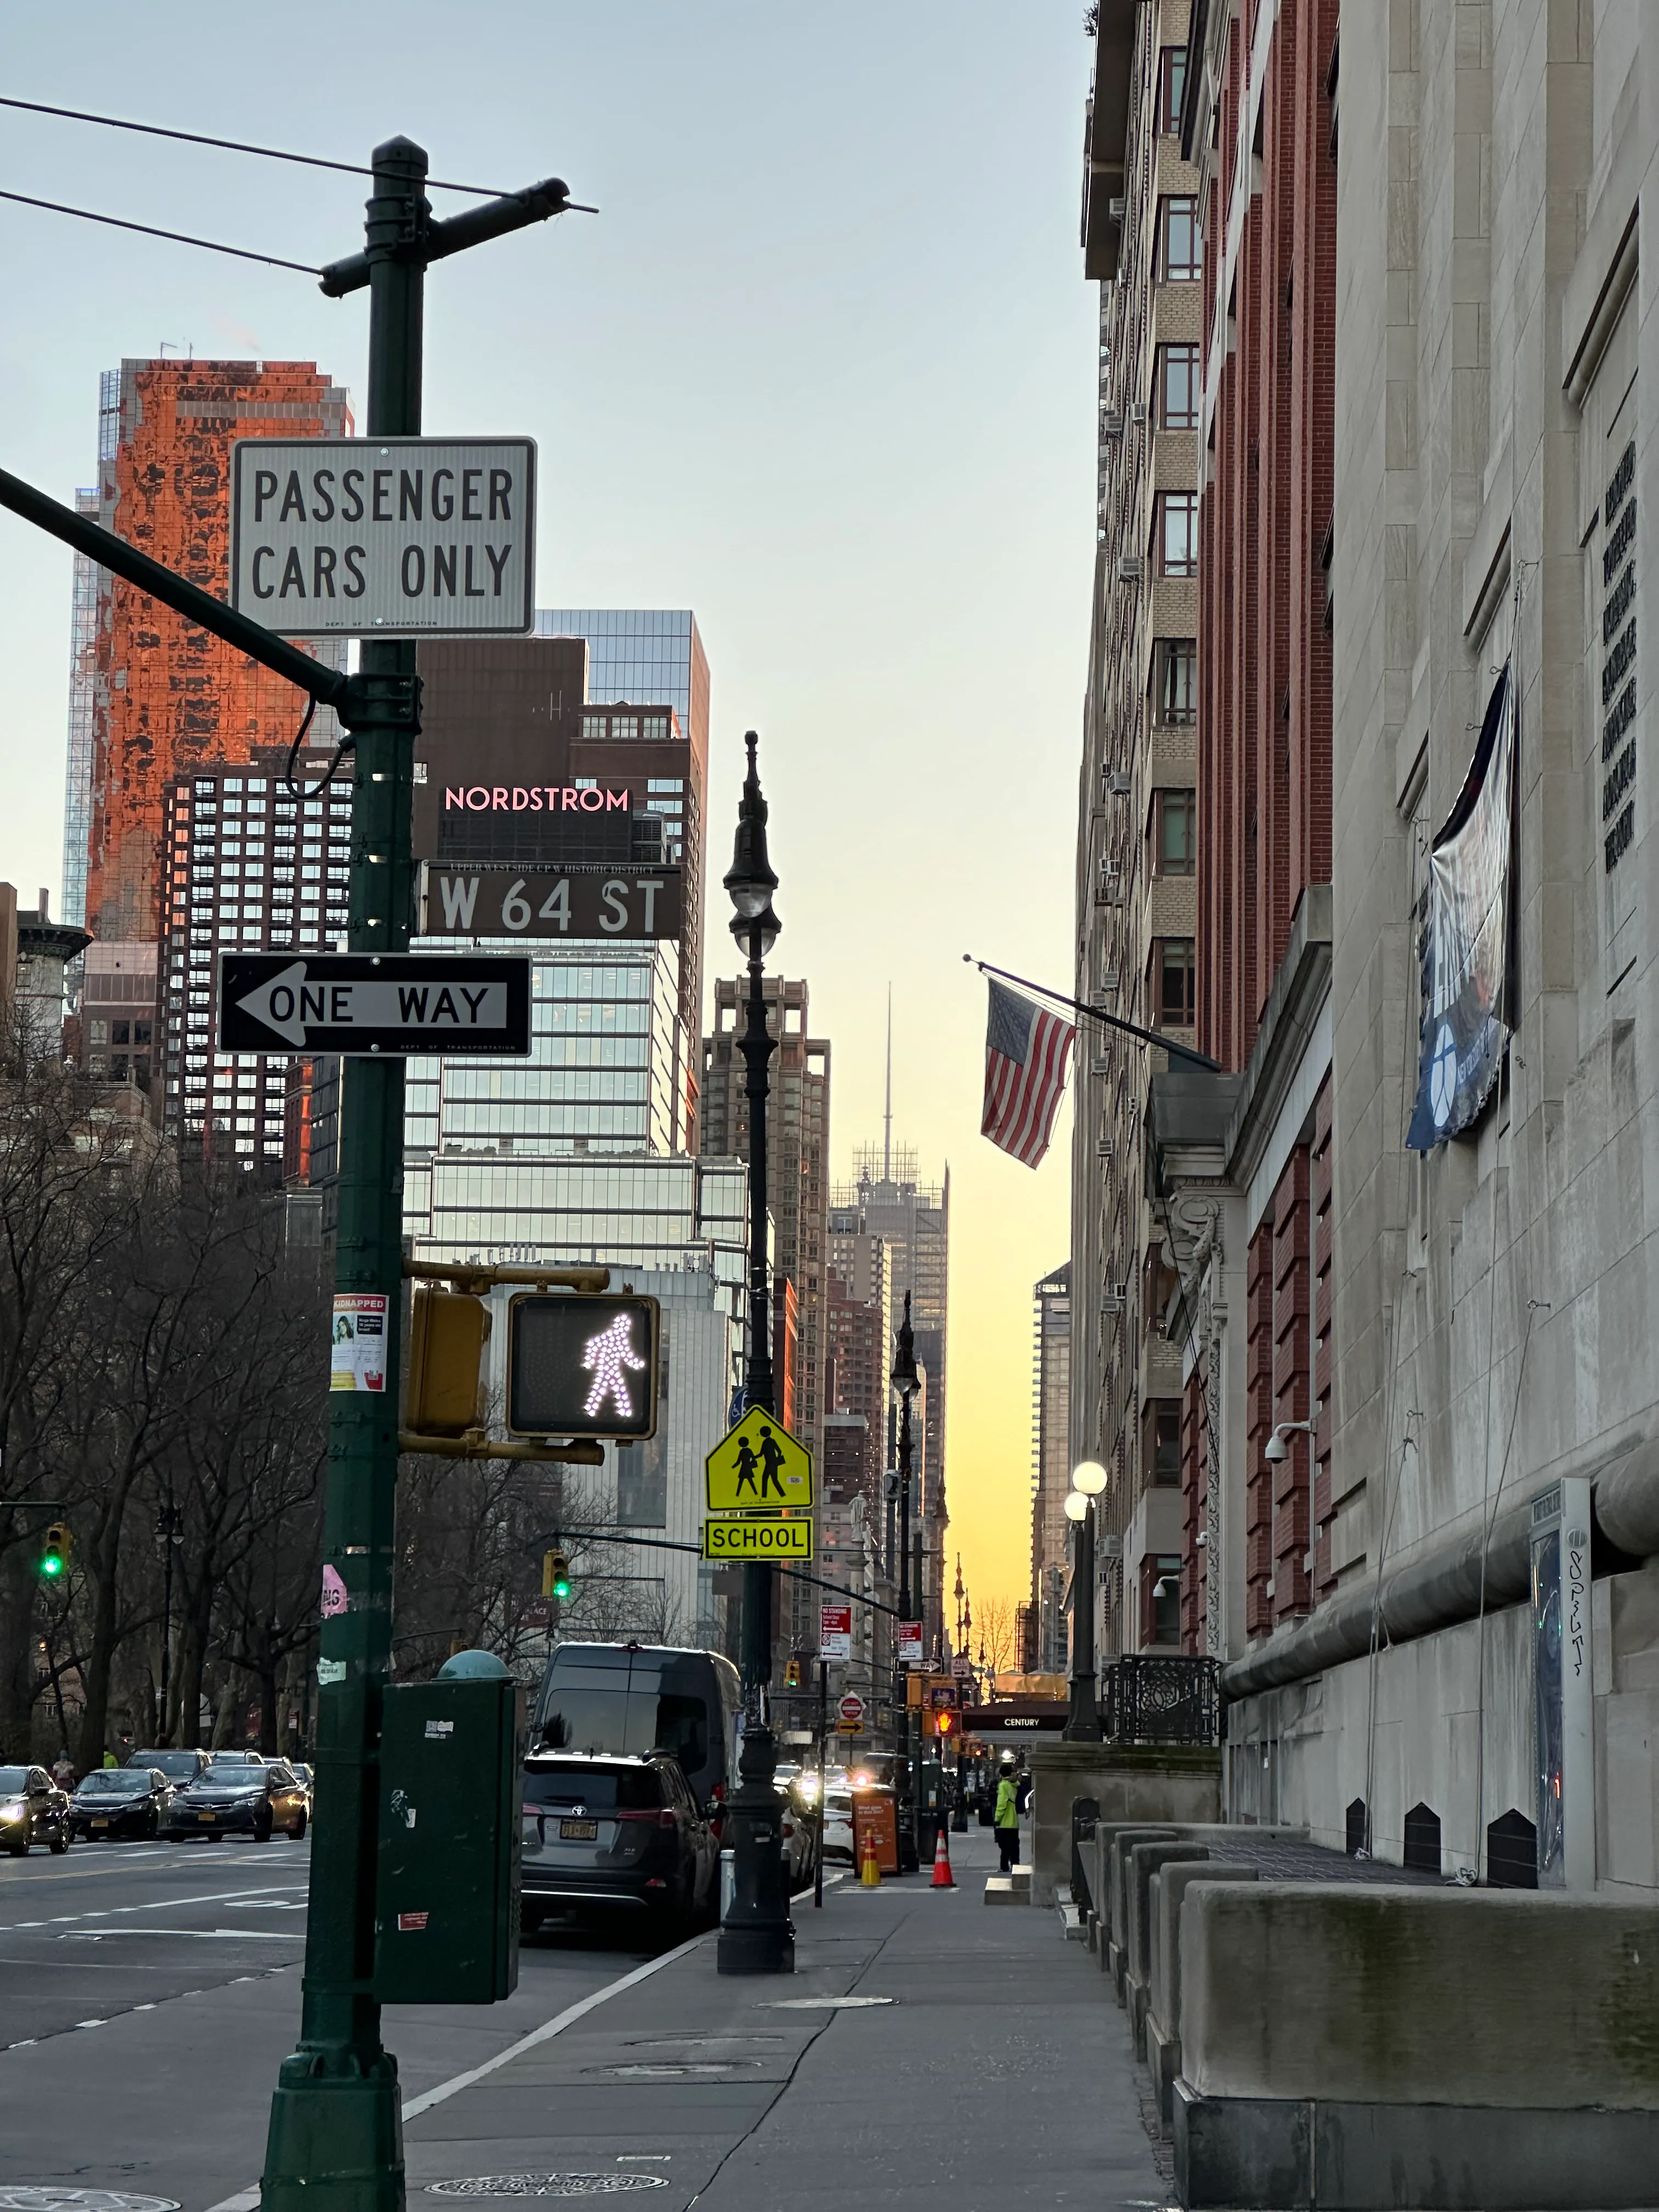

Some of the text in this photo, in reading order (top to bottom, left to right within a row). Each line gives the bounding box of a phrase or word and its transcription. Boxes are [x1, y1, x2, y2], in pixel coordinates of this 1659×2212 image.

[255, 469, 512, 522] PASSENGER
[252, 545, 512, 599] CARS ONLY
[445, 787, 628, 811] NORDSTROM
[450, 863, 482, 872] UPPER
[484, 864, 510, 872] WEST
[512, 864, 535, 873] SIDE
[565, 865, 610, 874] HISTORIC
[611, 866, 654, 875] DISTRICT
[440, 877, 664, 933] W 64 ST
[269, 985, 489, 1023] ONE WAY
[333, 1299, 383, 1308] KIDNAPPED
[712, 1528, 804, 1548] SCHOOL
